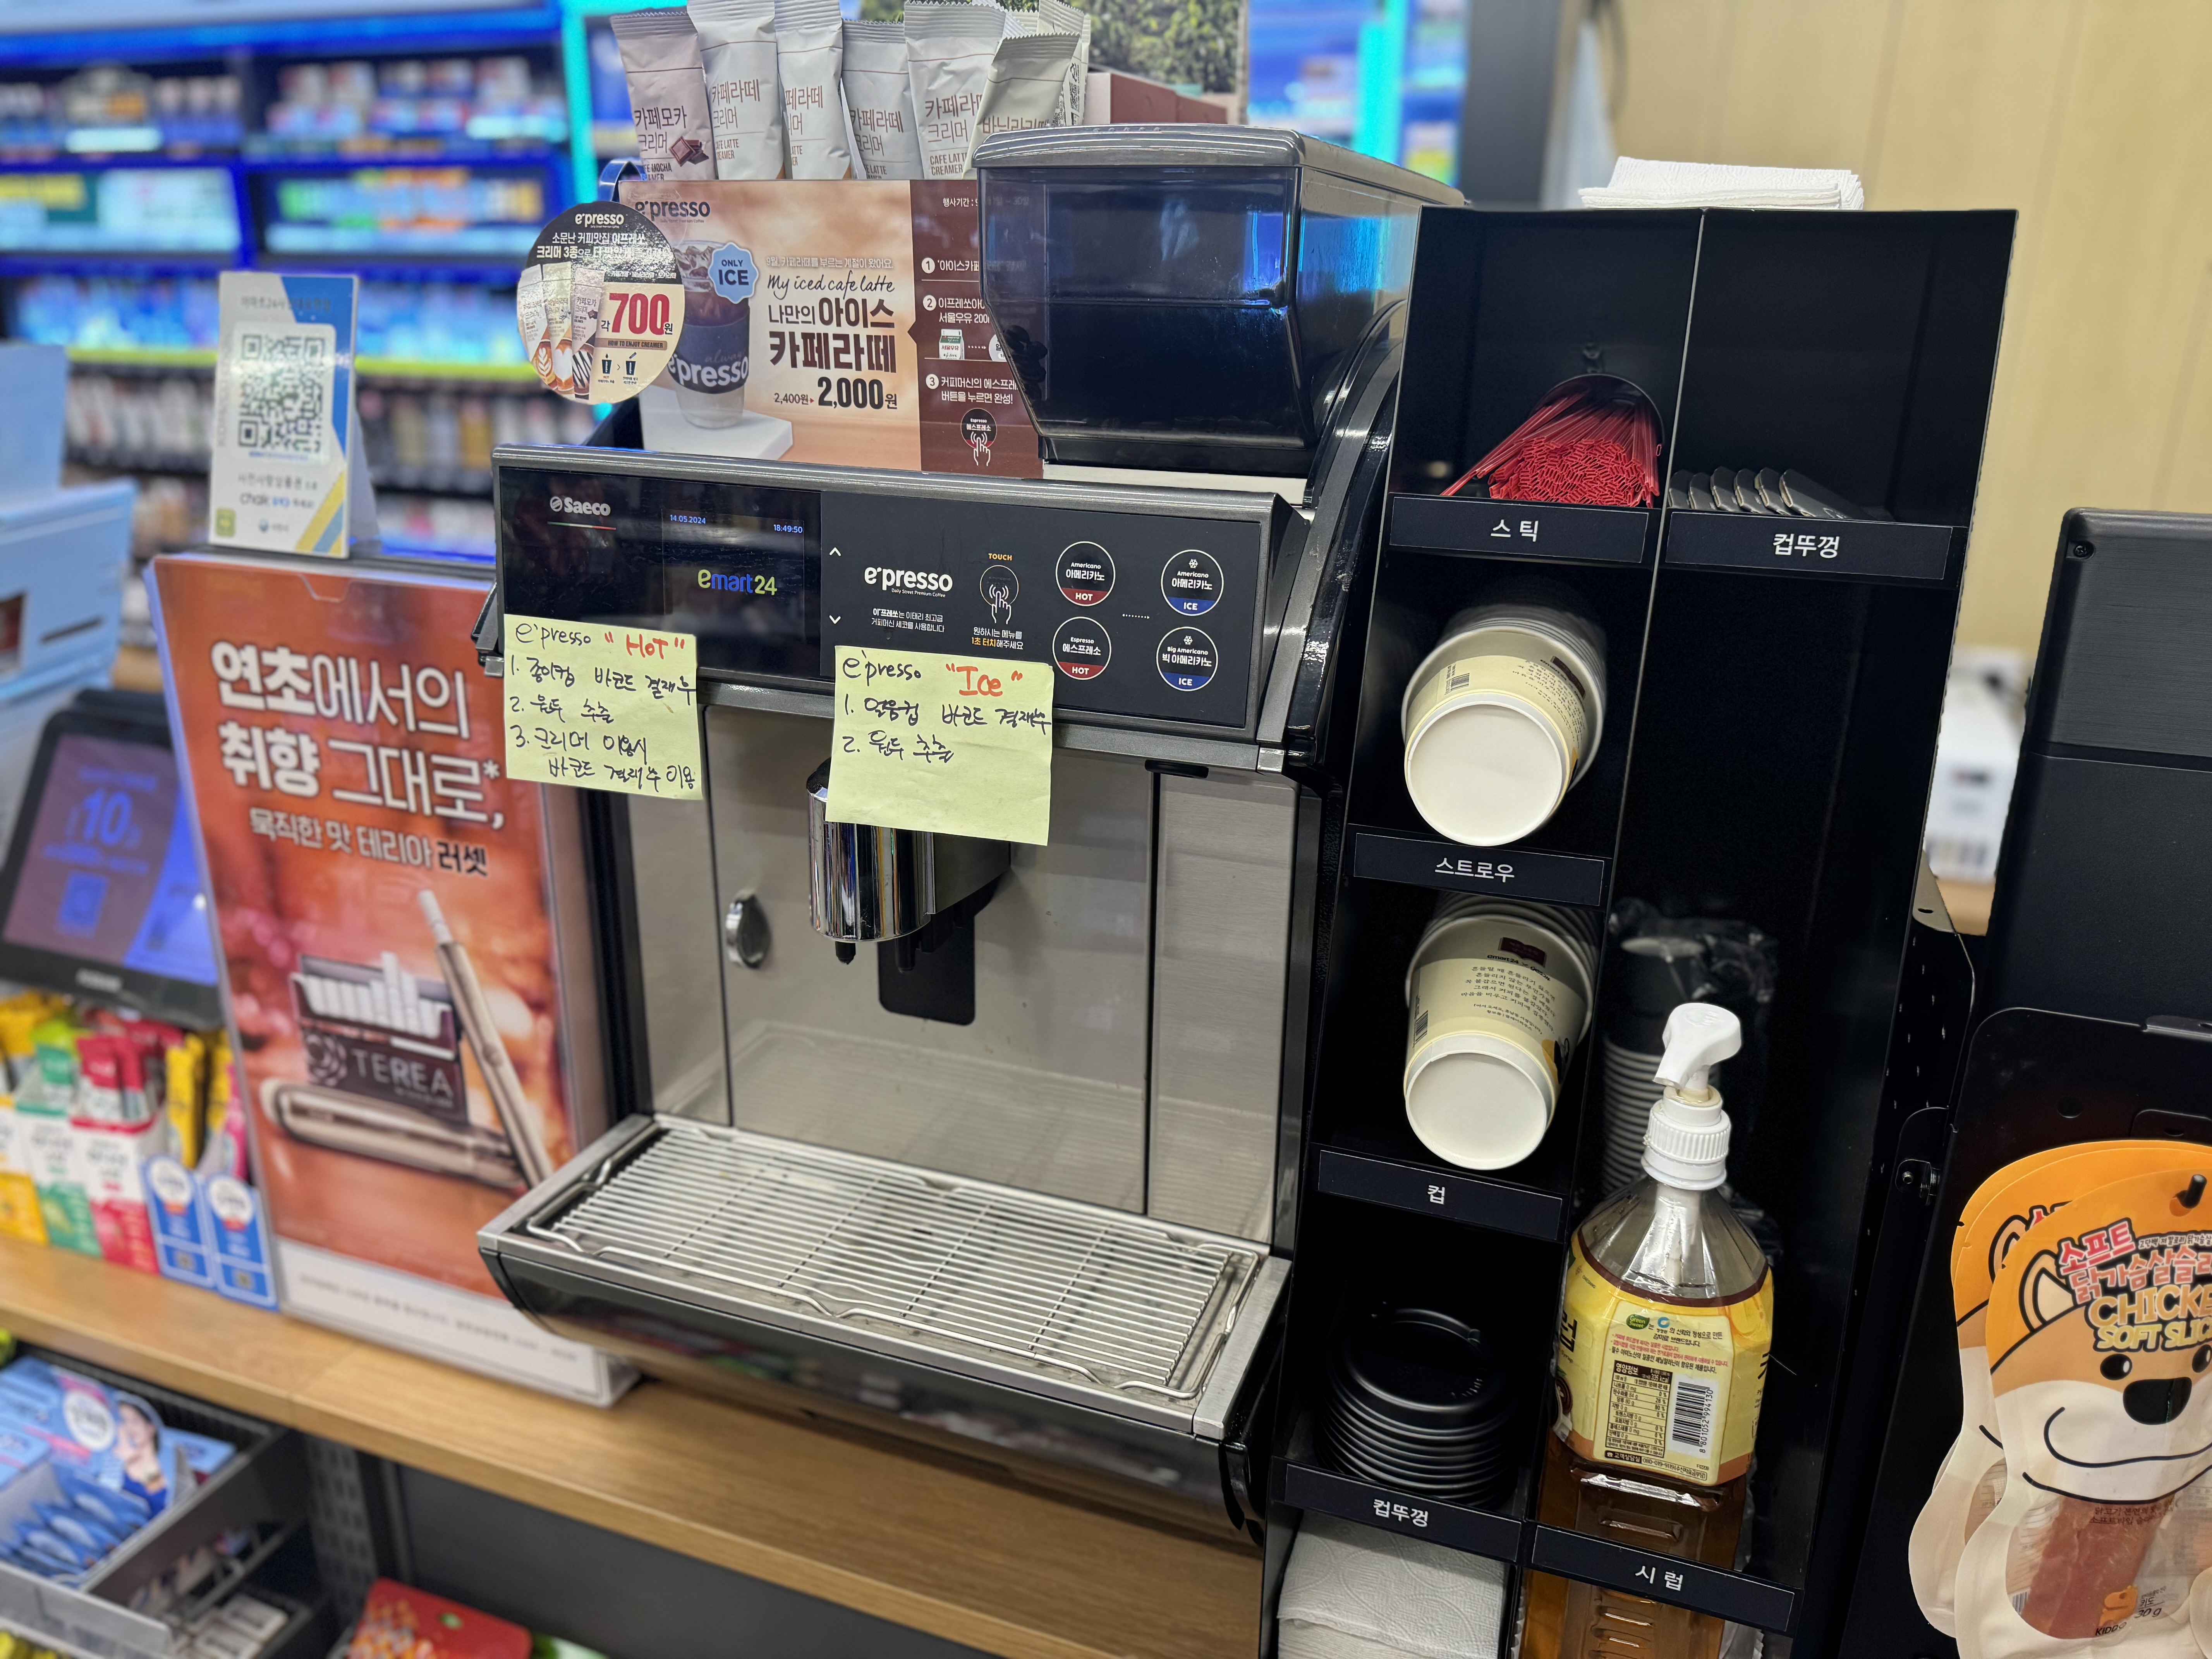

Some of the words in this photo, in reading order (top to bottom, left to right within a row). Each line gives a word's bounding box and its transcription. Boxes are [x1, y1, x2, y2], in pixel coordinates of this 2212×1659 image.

[712, 79, 760, 105] 카페라떼
[786, 86, 823, 110] 페라떼
[634, 106, 687, 130] 카페모카
[713, 107, 738, 129] 크리머
[850, 108, 903, 133] 카페라떼
[928, 120, 968, 143] 크리머
[638, 131, 667, 154] 크리머
[723, 138, 739, 149] LATTE
[930, 154, 947, 165] CAFE
[948, 152, 966, 164] LATT
[651, 163, 672, 172] MOCHA
[869, 166, 887, 175] LATTE
[931, 164, 963, 176] CREAMER
[943, 198, 969, 207] 행사기간
[552, 233, 575, 244] 소문난
[578, 233, 610, 244] 커피맛집
[537, 246, 562, 259] 크리머
[563, 246, 592, 259] 3종으로
[721, 259, 743, 268] ONLY
[781, 257, 818, 267] 카페라떼를
[820, 258, 843, 268] 부르는
[845, 258, 867, 268] 계절이
[718, 270, 749, 287] ICE
[768, 274, 790, 300] My
[794, 274, 826, 290] iced
[828, 270, 858, 300] cafe
[860, 275, 895, 292] latte
[768, 304, 814, 325] 나만의
[818, 297, 895, 329] 아이스
[939, 312, 972, 323] 서울우유
[601, 320, 610, 332] 각
[769, 331, 896, 373] 카페라떼
[941, 376, 982, 389] 커피머신의
[984, 379, 1018, 390] 에스프레
[941, 391, 966, 402] 버튼을
[968, 392, 992, 403] 누르면
[994, 393, 1013, 404] 완성!
[564, 496, 611, 516] Saeco
[670, 514, 706, 525] 14.05.2024
[774, 524, 803, 534] 18:49:50
[1773, 533, 1840, 558] 컵뚜껑
[988, 553, 1013, 561] TOUCH
[1071, 562, 1101, 570] Americano
[1066, 569, 1105, 581] 아메리카노
[698, 569, 777, 595] emart24
[1171, 578, 1212, 590] 아메리카노
[1075, 592, 1093, 601] HOT
[1183, 602, 1198, 610] ICE
[906, 611, 924, 621] 이태리
[925, 613, 943, 623] 최고급
[896, 620, 913, 630] 세코를
[914, 622, 945, 633] 사용합니다
[973, 627, 1000, 637] 원하시는
[1001, 630, 1022, 640] 메뉴를
[972, 637, 981, 646] 1초
[982, 638, 1024, 650] 터치해주세요
[1063, 643, 1101, 656] 에스프레소
[1177, 647, 1208, 655] Americano
[1162, 653, 1170, 663] 빅
[1171, 654, 1212, 667] 아메리카노
[526, 656, 575, 687] 종이컵
[595, 667, 636, 691] 바코드
[1072, 666, 1089, 675] HOT
[1178, 678, 1192, 686] ICE
[211, 641, 470, 740] 연초에서의
[581, 698, 614, 723] 추출
[864, 697, 919, 726] 얼음컵
[942, 704, 988, 727] 바코드
[534, 727, 589, 752] 크리머
[603, 735, 647, 765] 이용시
[868, 730, 904, 761] 원두
[913, 734, 954, 763] 추출
[218, 721, 321, 798] 취향
[548, 756, 595, 778] 바코드
[249, 807, 323, 850] 묵직한
[325, 820, 352, 854] 맛
[356, 825, 432, 869] 테리아
[436, 841, 489, 878] 러셋
[1435, 857, 1515, 882] 스트로우
[1487, 954, 1519, 964] emart24
[350, 1048, 455, 1098] TEREA
[1427, 1185, 1446, 1205] 컵
[2059, 1221, 2135, 1275] 소프트
[2138, 1237, 2159, 1250] 고단백
[2159, 1235, 2186, 1247] 저칼로리
[1630, 1315, 1645, 1324] Green
[1653, 1333, 1669, 1342] 감미료
[1676, 1328, 1691, 1336] 신뢰와
[1692, 1330, 1711, 1339] 정성으로
[1712, 1331, 1723, 1340] 만든
[2097, 1324, 2162, 1349] SOFT
[1621, 1348, 1641, 1359] 아미노산의
[1616, 1363, 1638, 1375] 영양정보
[1704, 1389, 1714, 1419] 994130
[1701, 1419, 1710, 1446] 801052
[1614, 1453, 1640, 1463] 고객상담실
[1372, 1499, 1429, 1528] 컵뚜껑
[2140, 1597, 2154, 1607] 키도
[2134, 1608, 2152, 1619] 30
[2152, 1608, 2162, 1617] g
[2095, 1621, 2127, 1636] KIDDO
